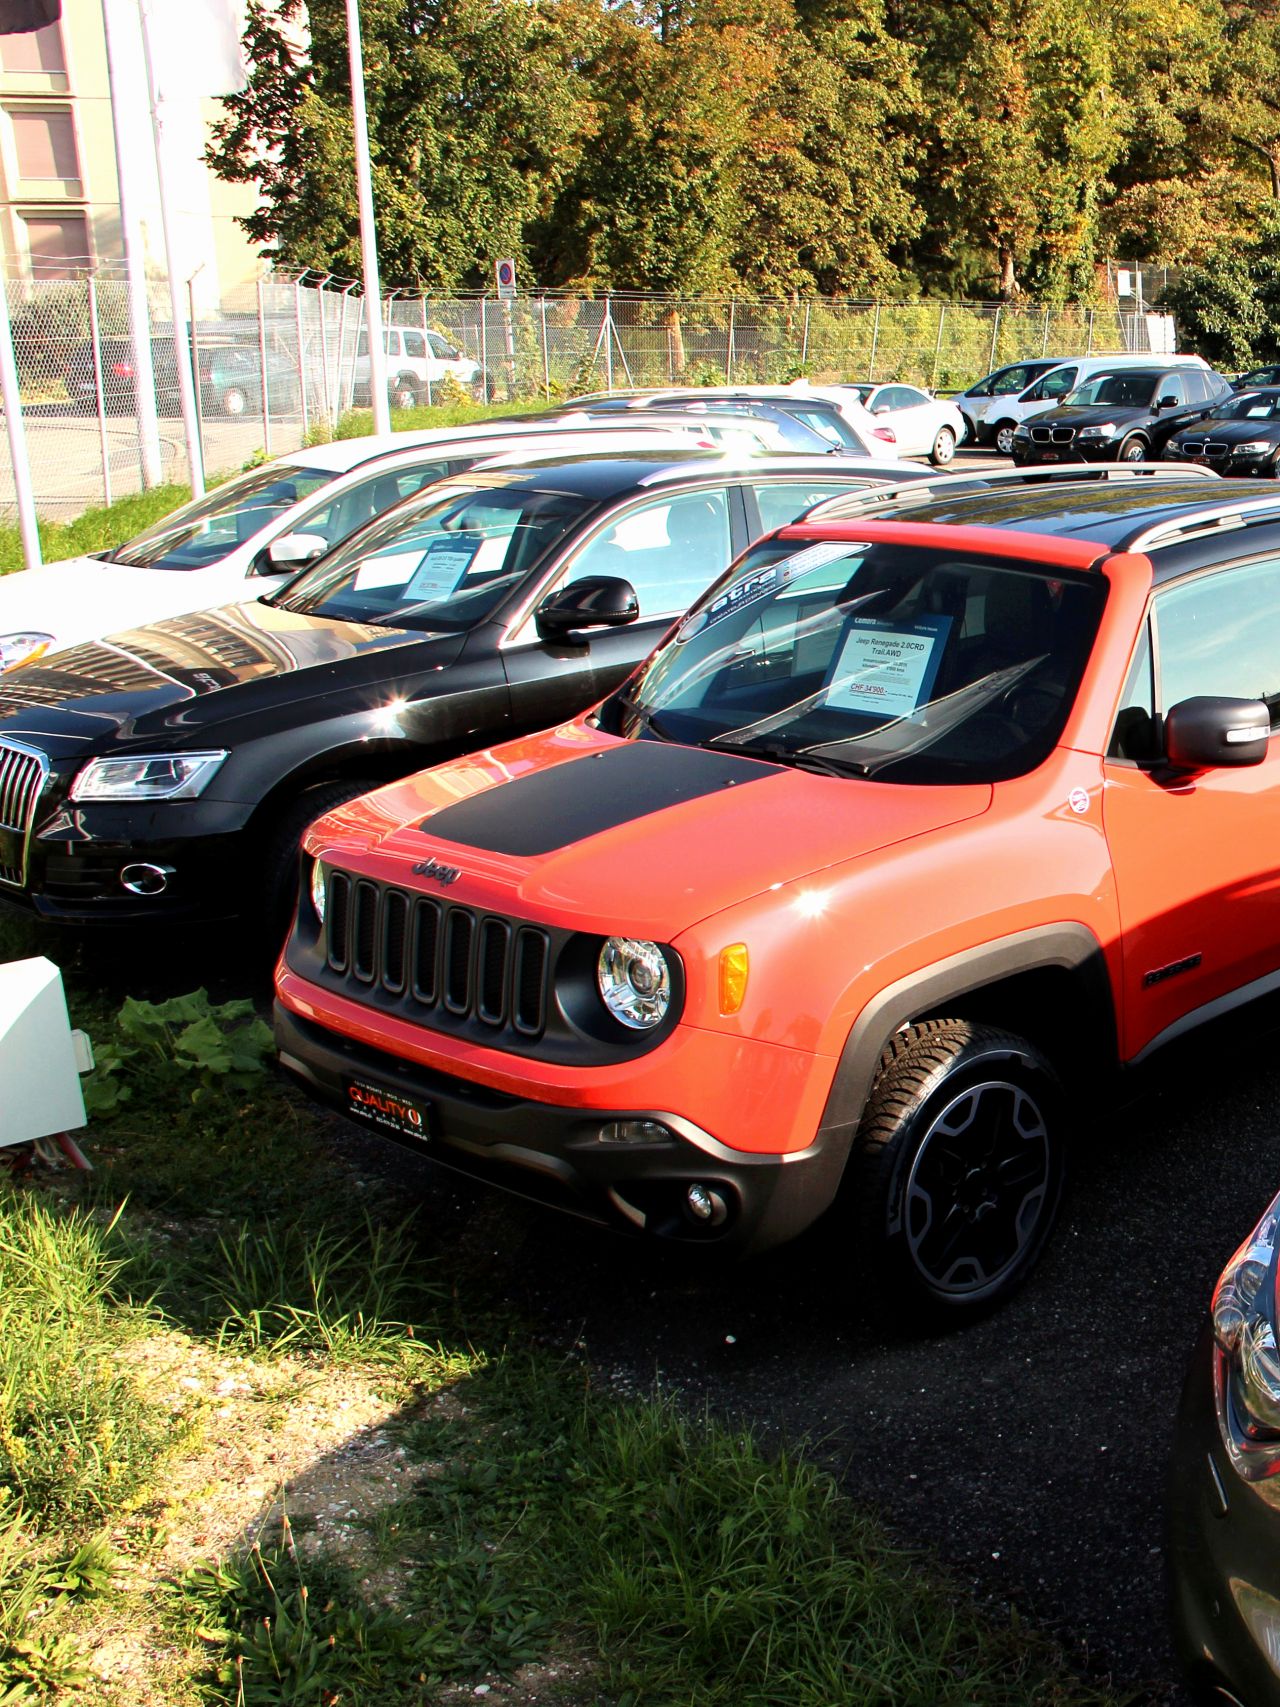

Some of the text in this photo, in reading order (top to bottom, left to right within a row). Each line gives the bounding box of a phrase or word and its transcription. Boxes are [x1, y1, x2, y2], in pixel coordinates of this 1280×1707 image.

[711, 569, 777, 613] atra
[870, 638, 900, 648] Renegade
[850, 683, 864, 691] CHF
[412, 857, 462, 888] Jeep
[349, 1086, 406, 1118] QUALITY
